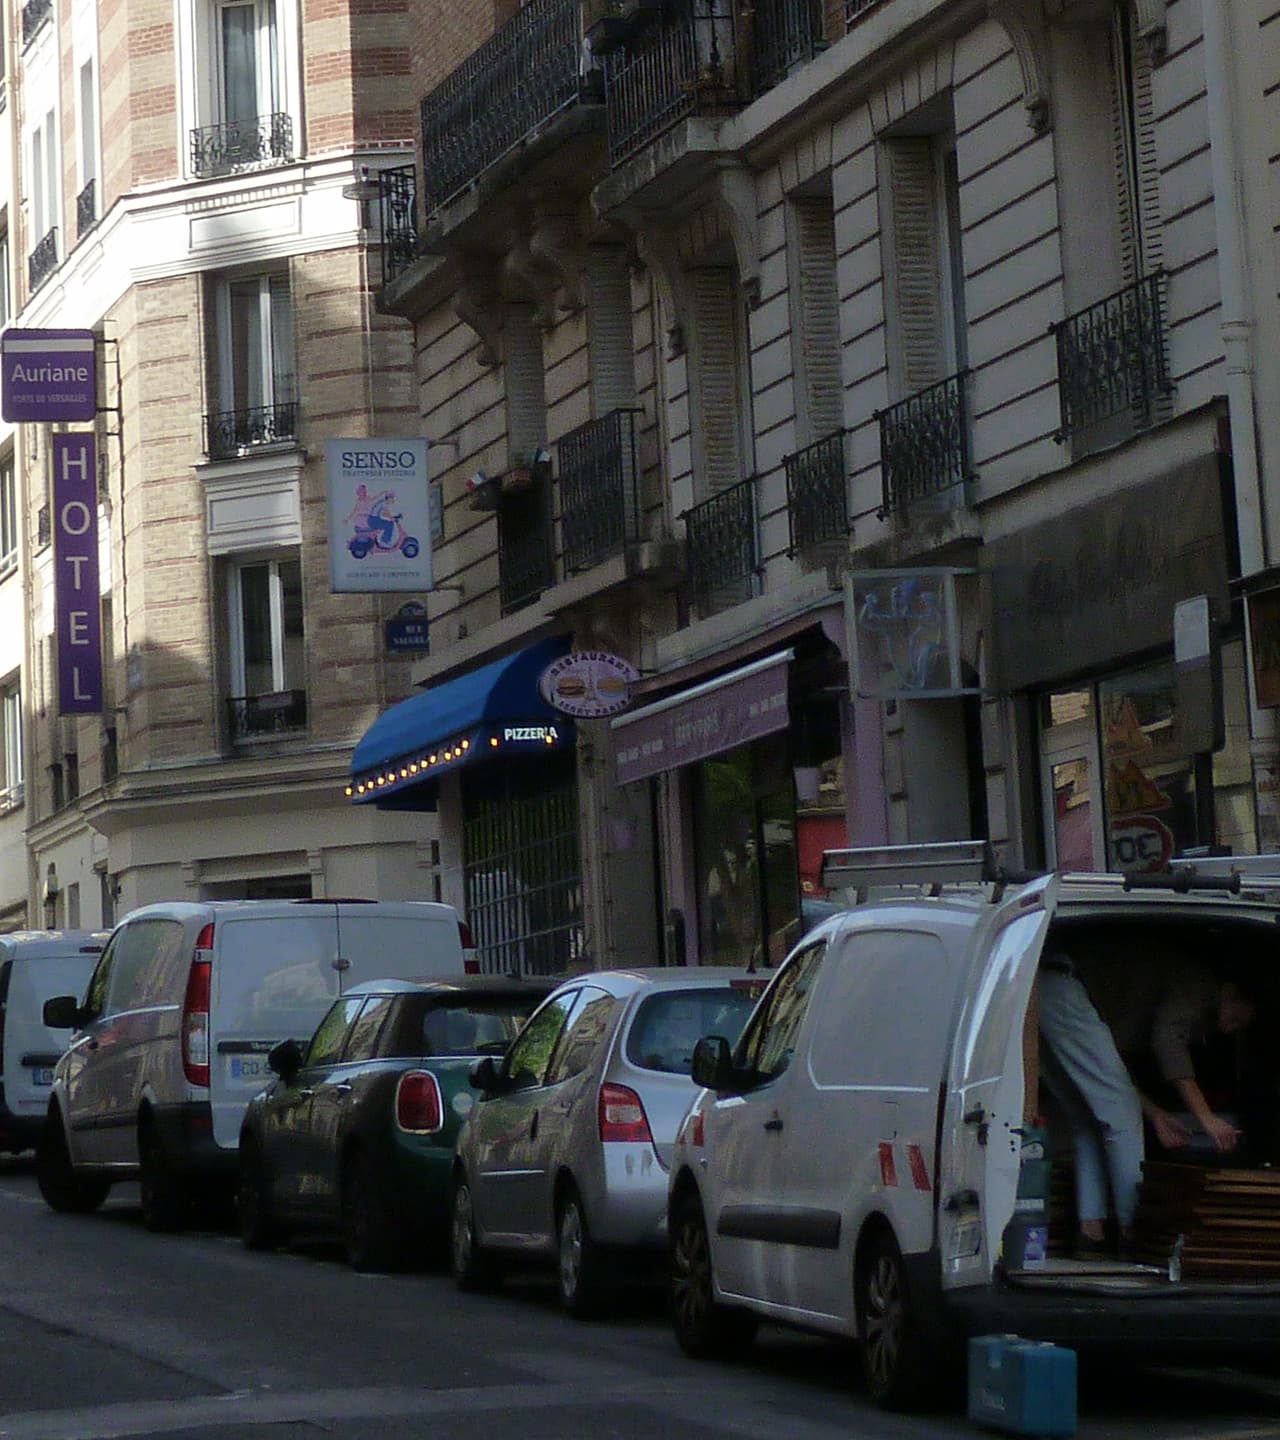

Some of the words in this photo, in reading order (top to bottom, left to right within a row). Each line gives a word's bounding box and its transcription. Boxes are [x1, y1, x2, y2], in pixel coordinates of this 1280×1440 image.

[11, 362, 89, 382] Auriane
[341, 451, 416, 469] SENSO
[61, 446, 92, 702] HOTEL
[504, 726, 558, 741] PIZZERIA
